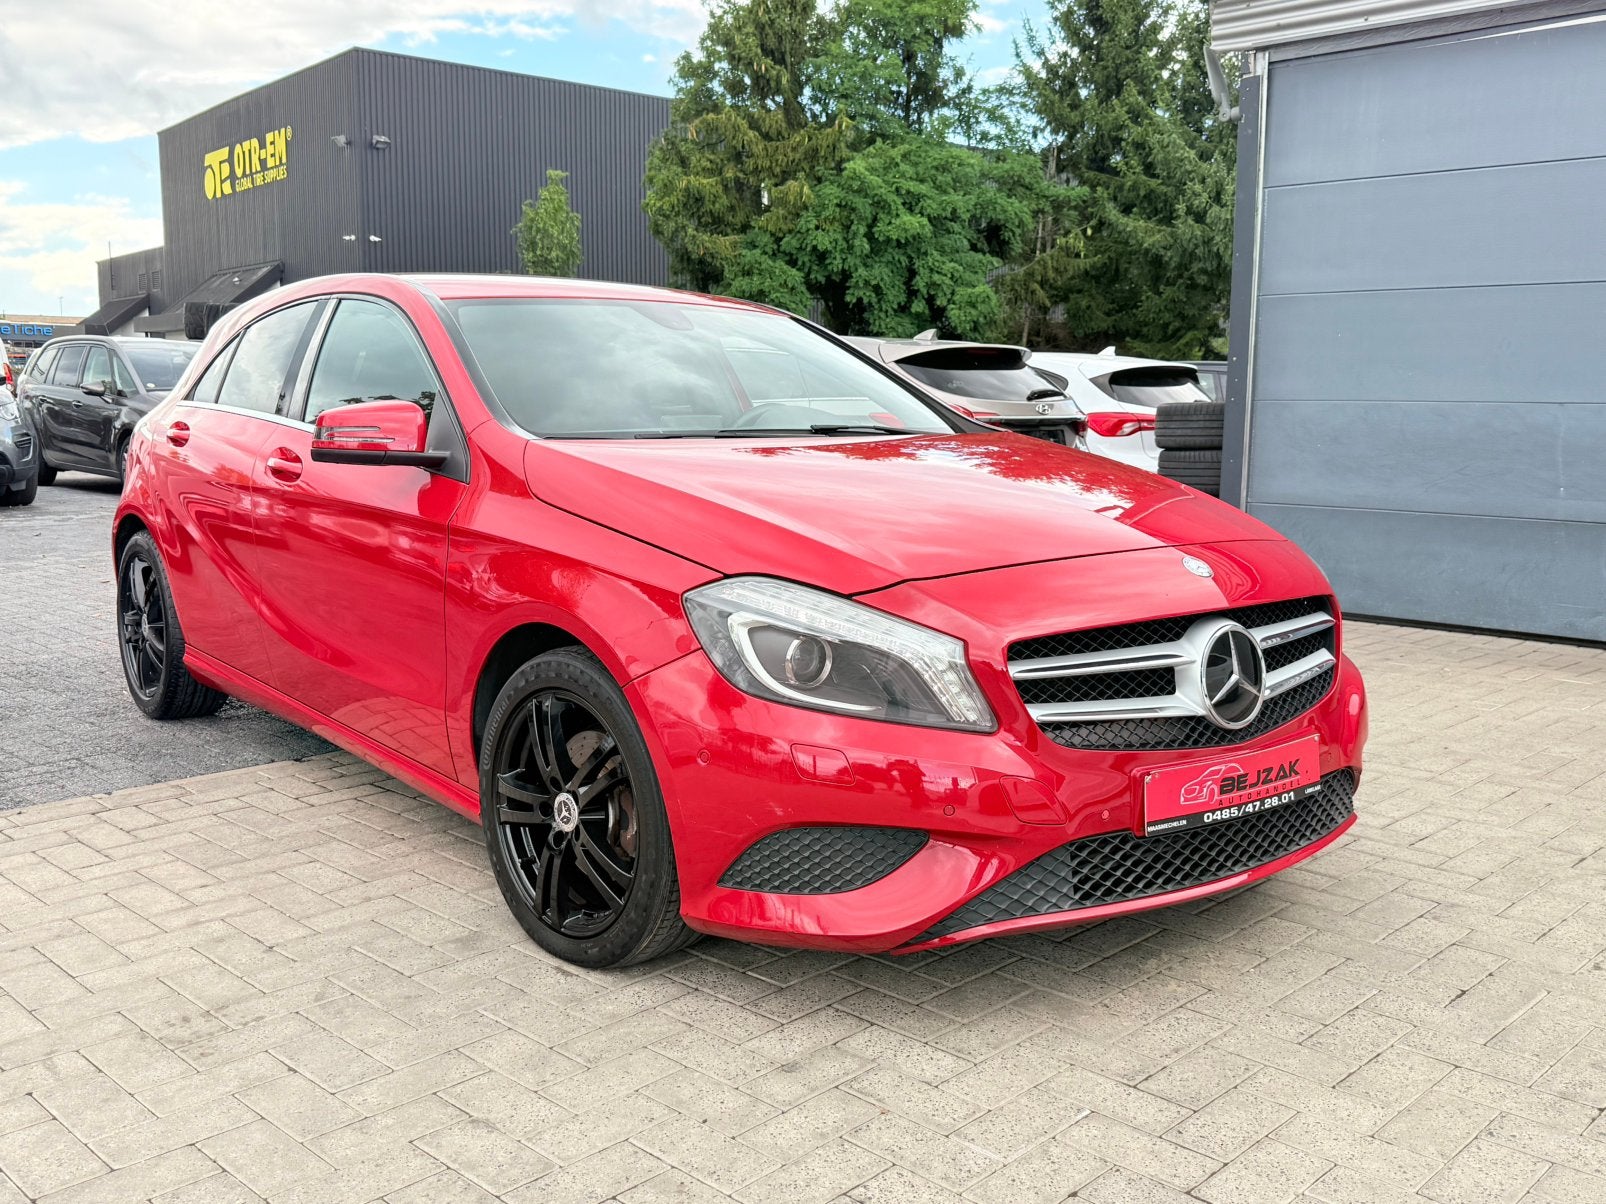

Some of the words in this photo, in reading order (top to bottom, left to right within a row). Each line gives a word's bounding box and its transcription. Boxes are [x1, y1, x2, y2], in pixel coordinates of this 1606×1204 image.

[235, 175, 253, 193] GLOBAL
[264, 165, 287, 184] SUPPLIES
[1219, 759, 1300, 795] BEJZAK
[1203, 791, 1295, 823] 0485/47.28.01
[1218, 779, 1301, 807] AUTOHANDEL
